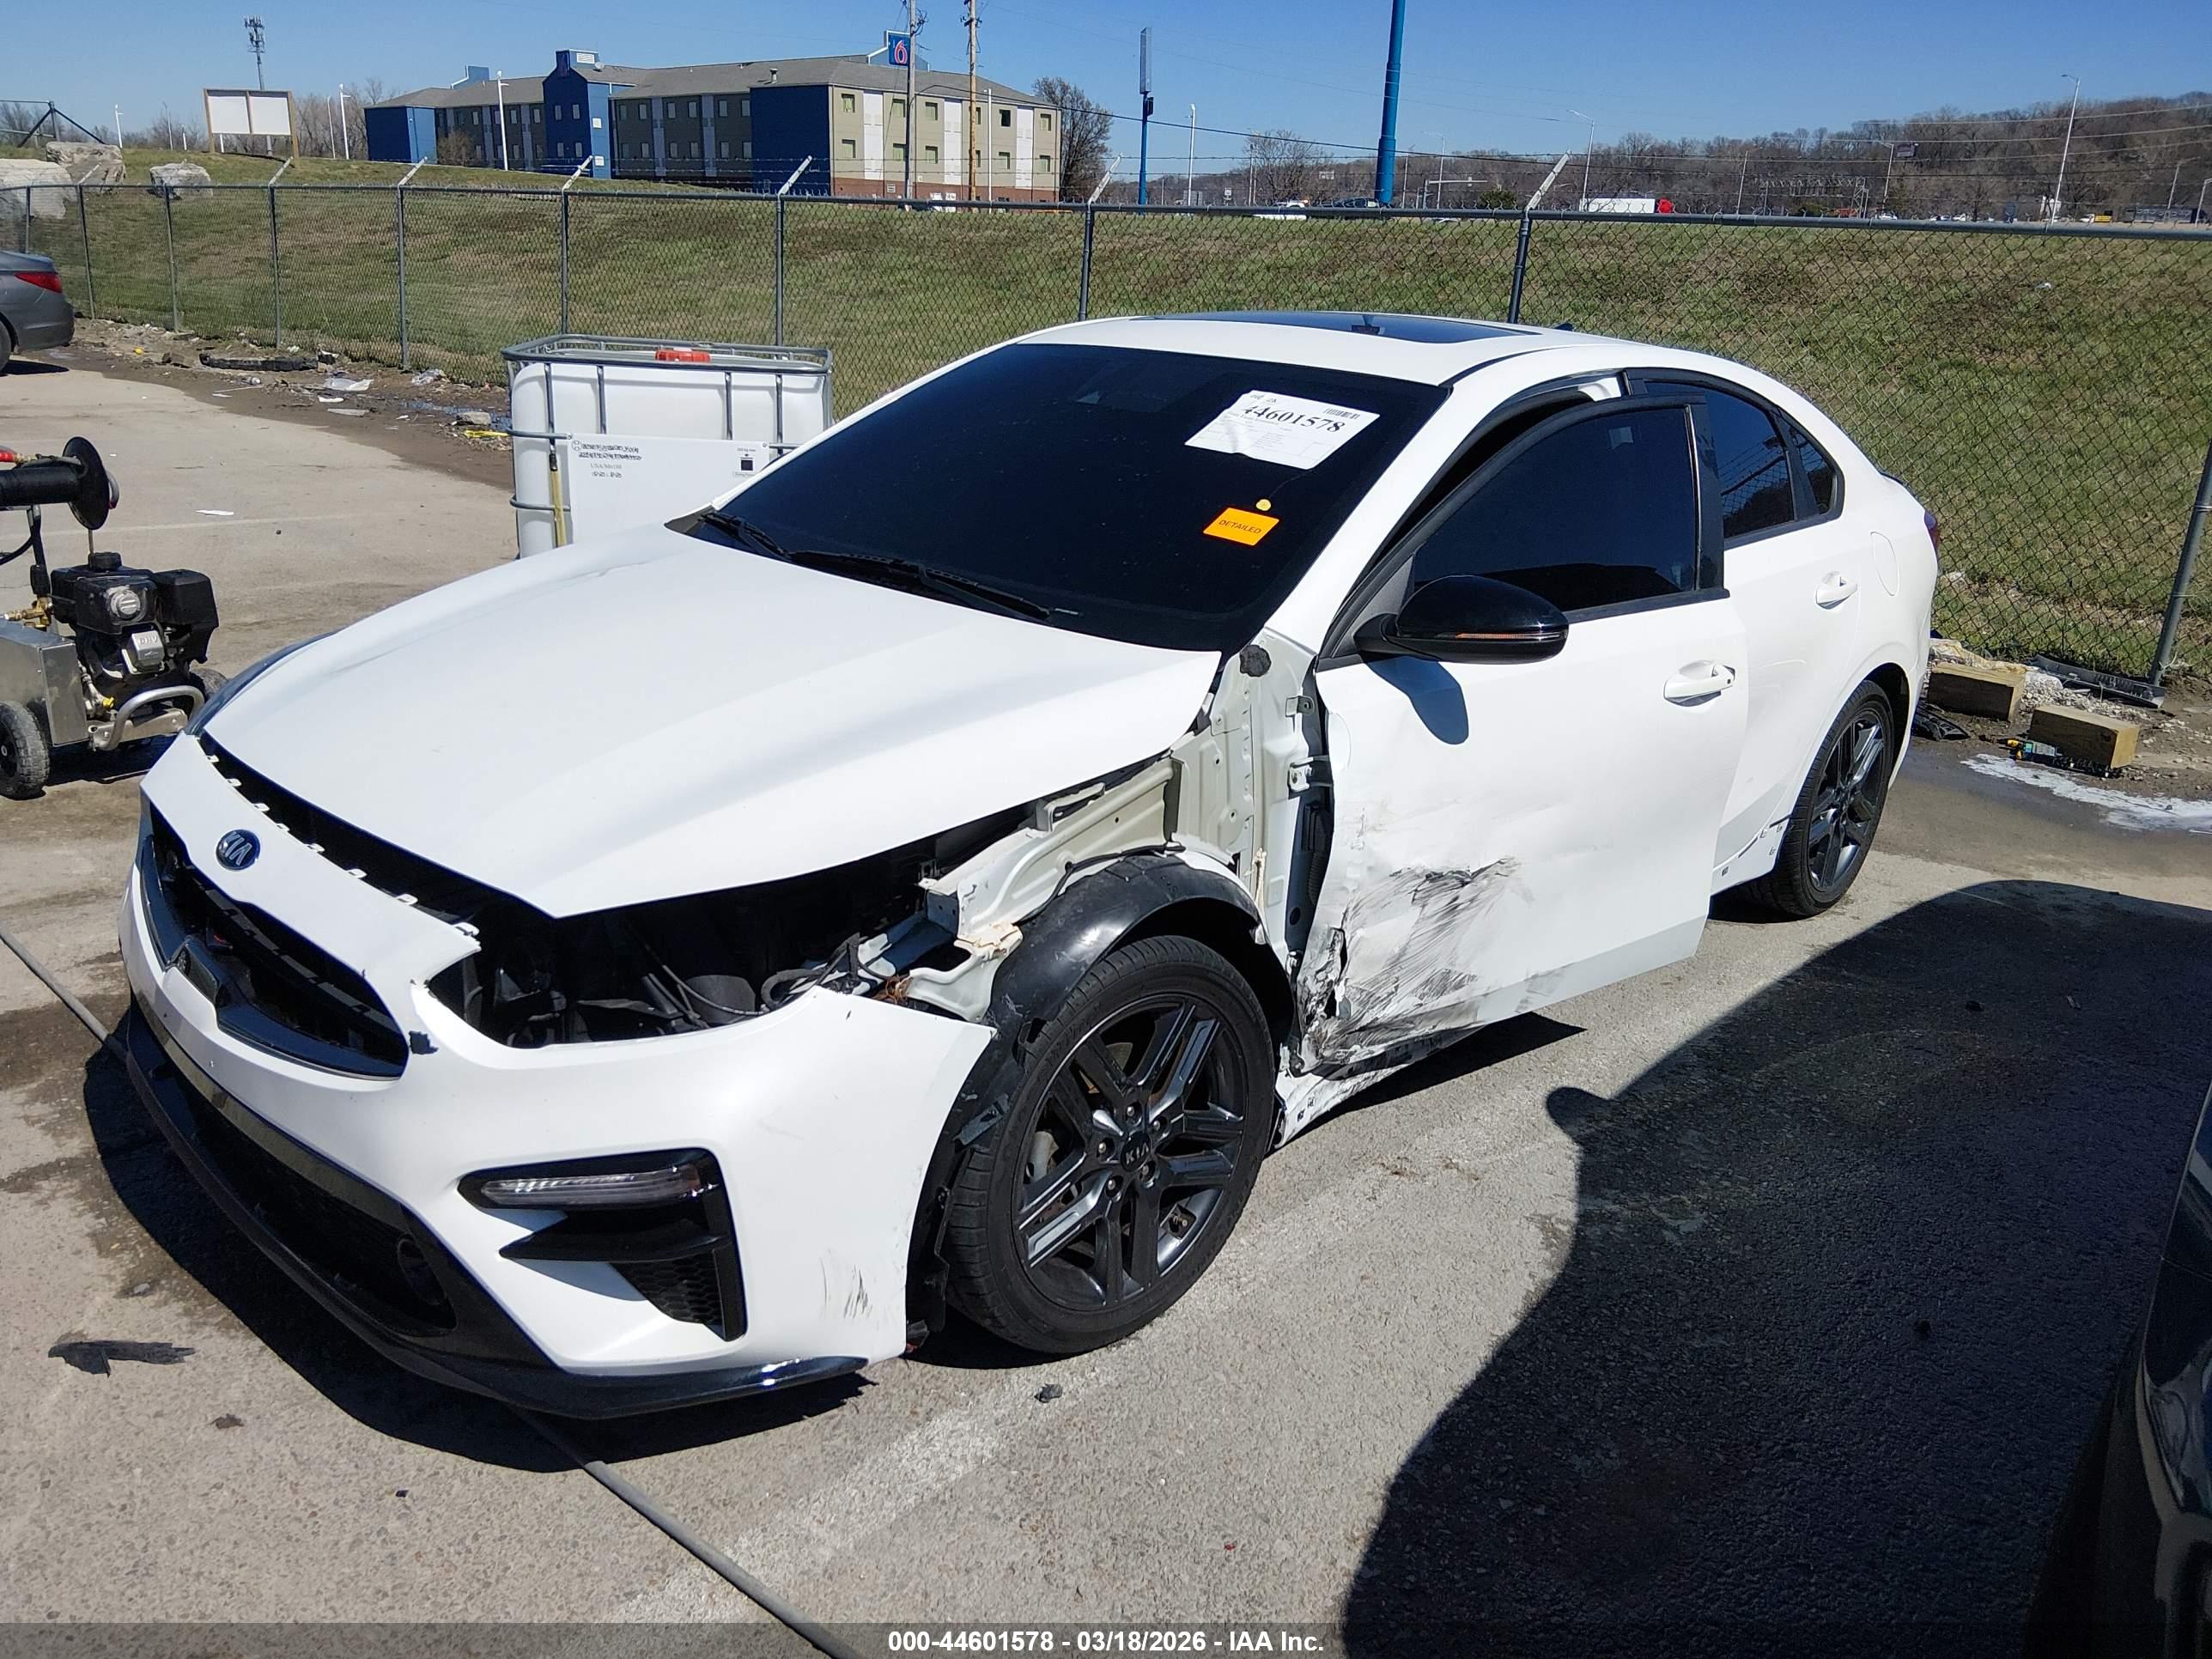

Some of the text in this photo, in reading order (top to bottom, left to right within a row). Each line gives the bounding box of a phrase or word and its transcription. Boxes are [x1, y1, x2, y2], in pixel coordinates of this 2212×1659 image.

[895, 40, 908, 64] 6
[1243, 405, 1346, 433] 44601578
[1218, 520, 1261, 534] DETAILED
[219, 831, 252, 866] KIA
[1126, 1143, 1149, 1164] KIA
